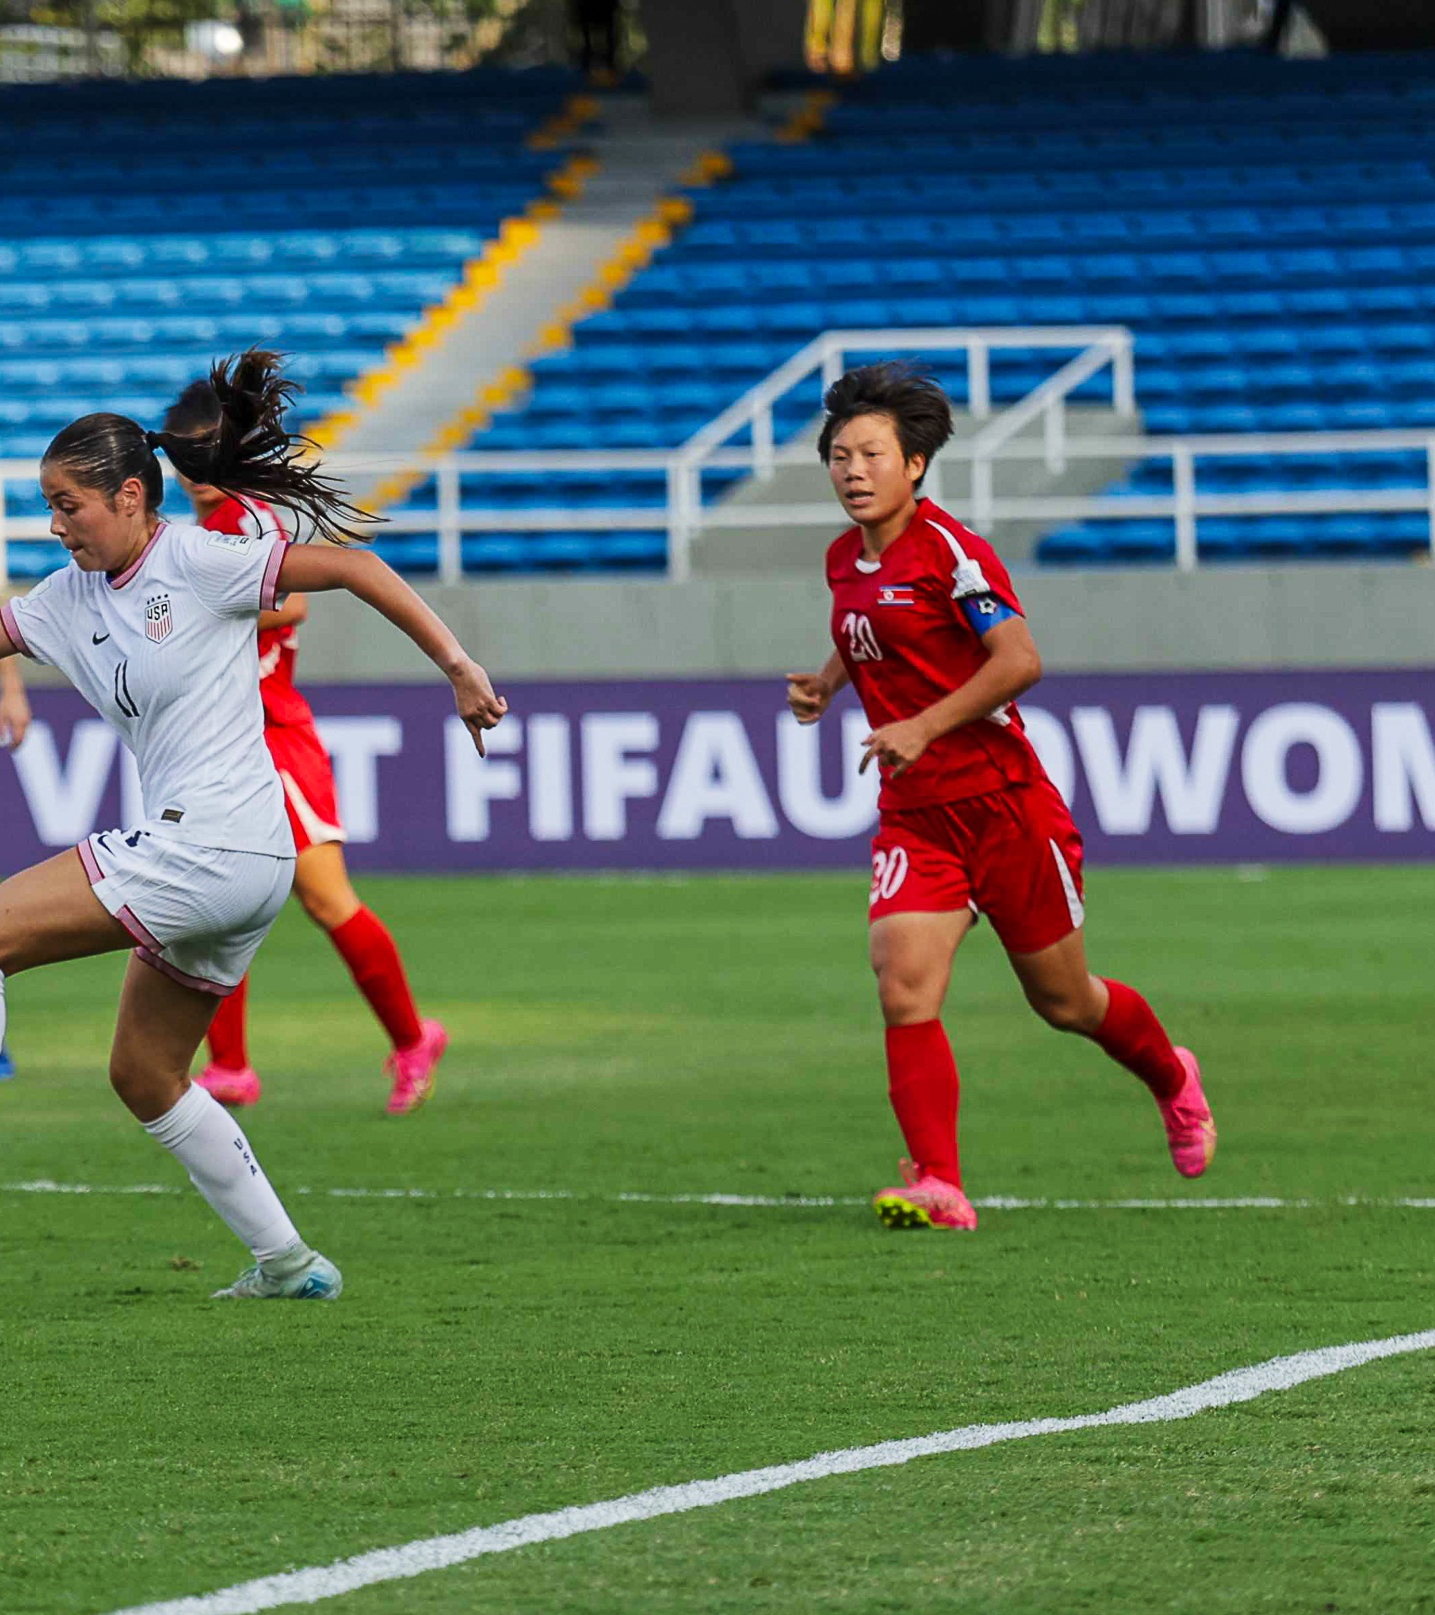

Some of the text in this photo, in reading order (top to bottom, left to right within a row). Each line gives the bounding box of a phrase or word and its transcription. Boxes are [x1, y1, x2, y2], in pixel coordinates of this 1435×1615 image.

[145, 603, 169, 621] USA
[841, 611, 883, 662] 20
[115, 659, 140, 718] 11
[11, 702, 1435, 844] VT FIFAUWO
